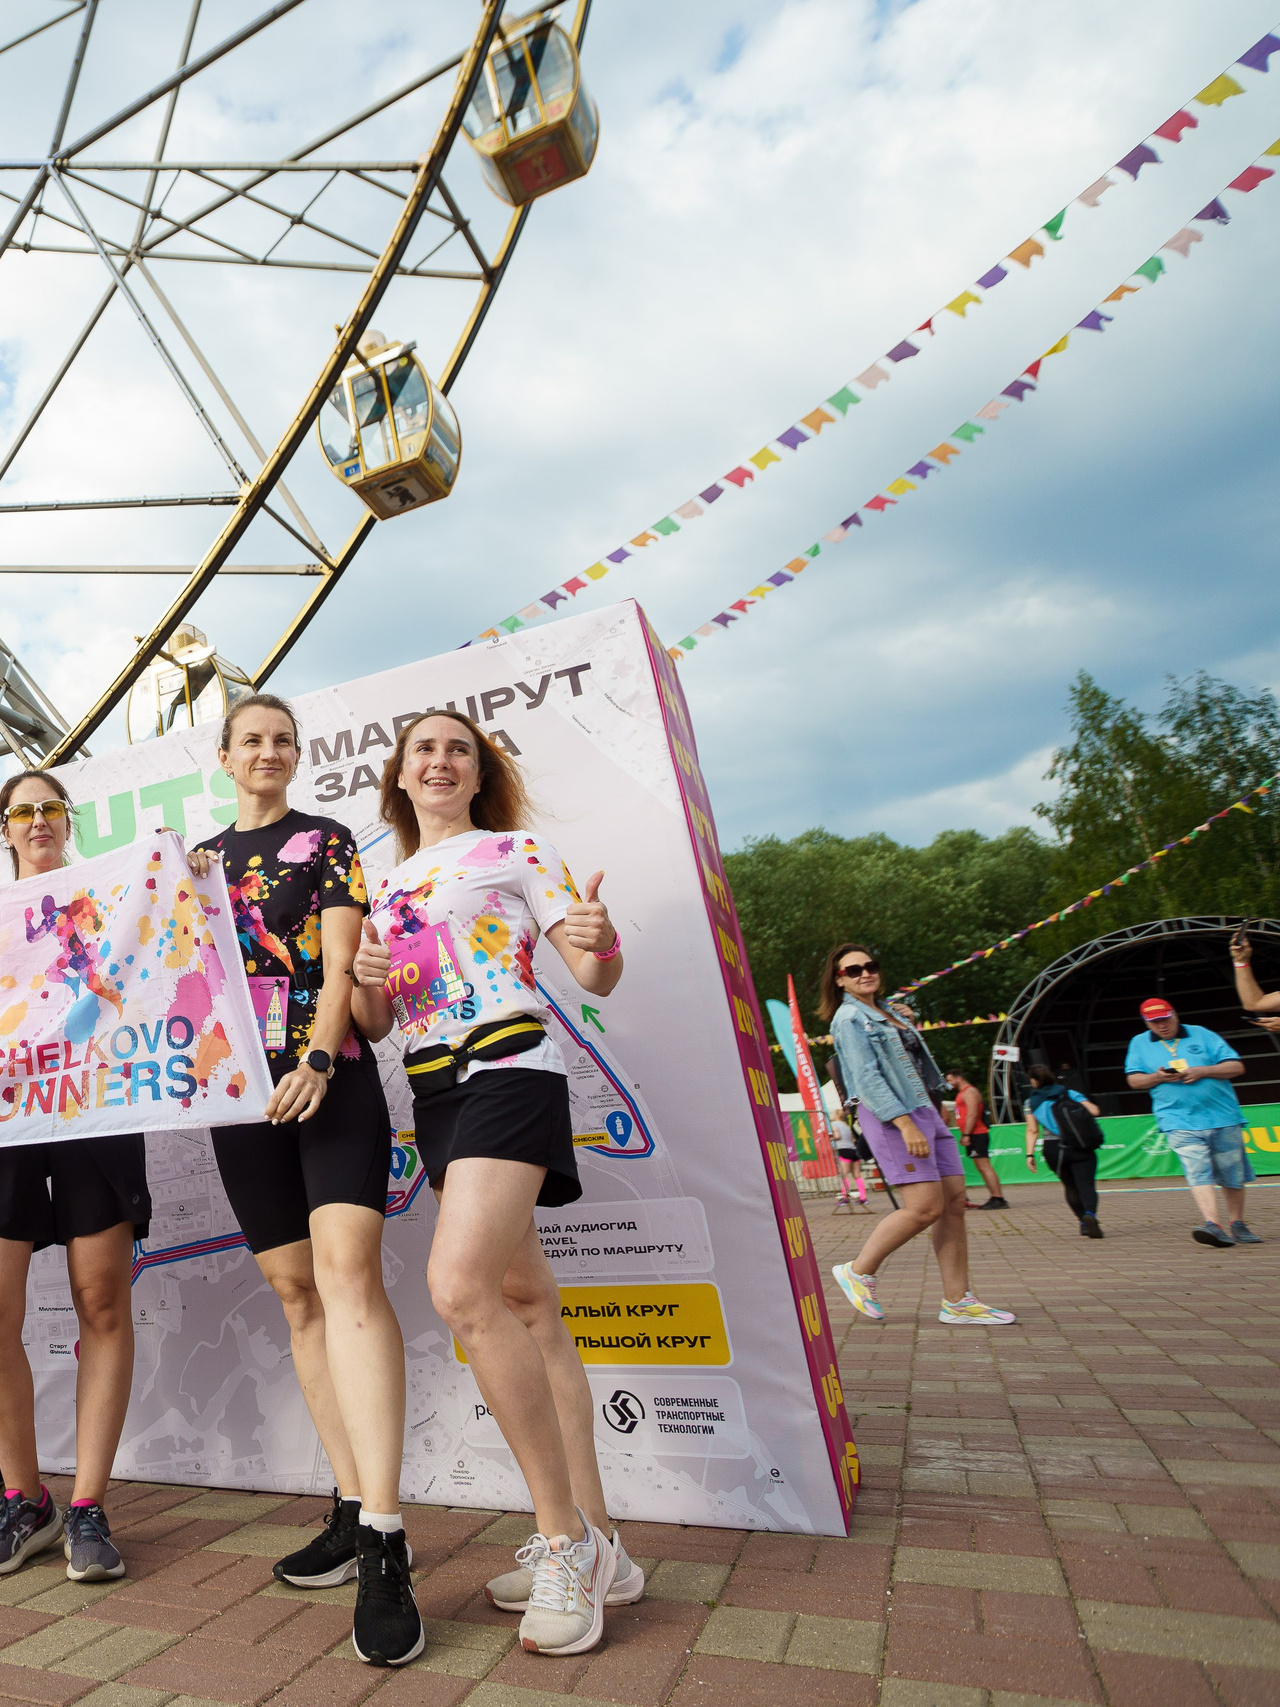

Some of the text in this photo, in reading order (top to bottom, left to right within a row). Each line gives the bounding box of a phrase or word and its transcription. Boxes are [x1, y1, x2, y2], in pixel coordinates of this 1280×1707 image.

[314, 729, 523, 803] ЗАА
[73, 768, 239, 859] UTS
[384, 962, 420, 996] 170
[434, 980, 441, 991] 1
[565, 1222, 637, 1233] АУДИОГИД
[539, 1237, 577, 1246] RAVEL
[544, 1244, 683, 1260] ЕДУЙ ПО МАРШРУТУ
[561, 1302, 679, 1317] АЛЫЙ КРУГ
[575, 1333, 711, 1348] ЛЬШОЙ КРУГ
[654, 1398, 718, 1408] СОВРЕМЕННЫЕ
[655, 1411, 725, 1421] ТРАНСПОРТНЫЕ
[658, 1424, 714, 1434] ТЕХНОЛОГИИ
